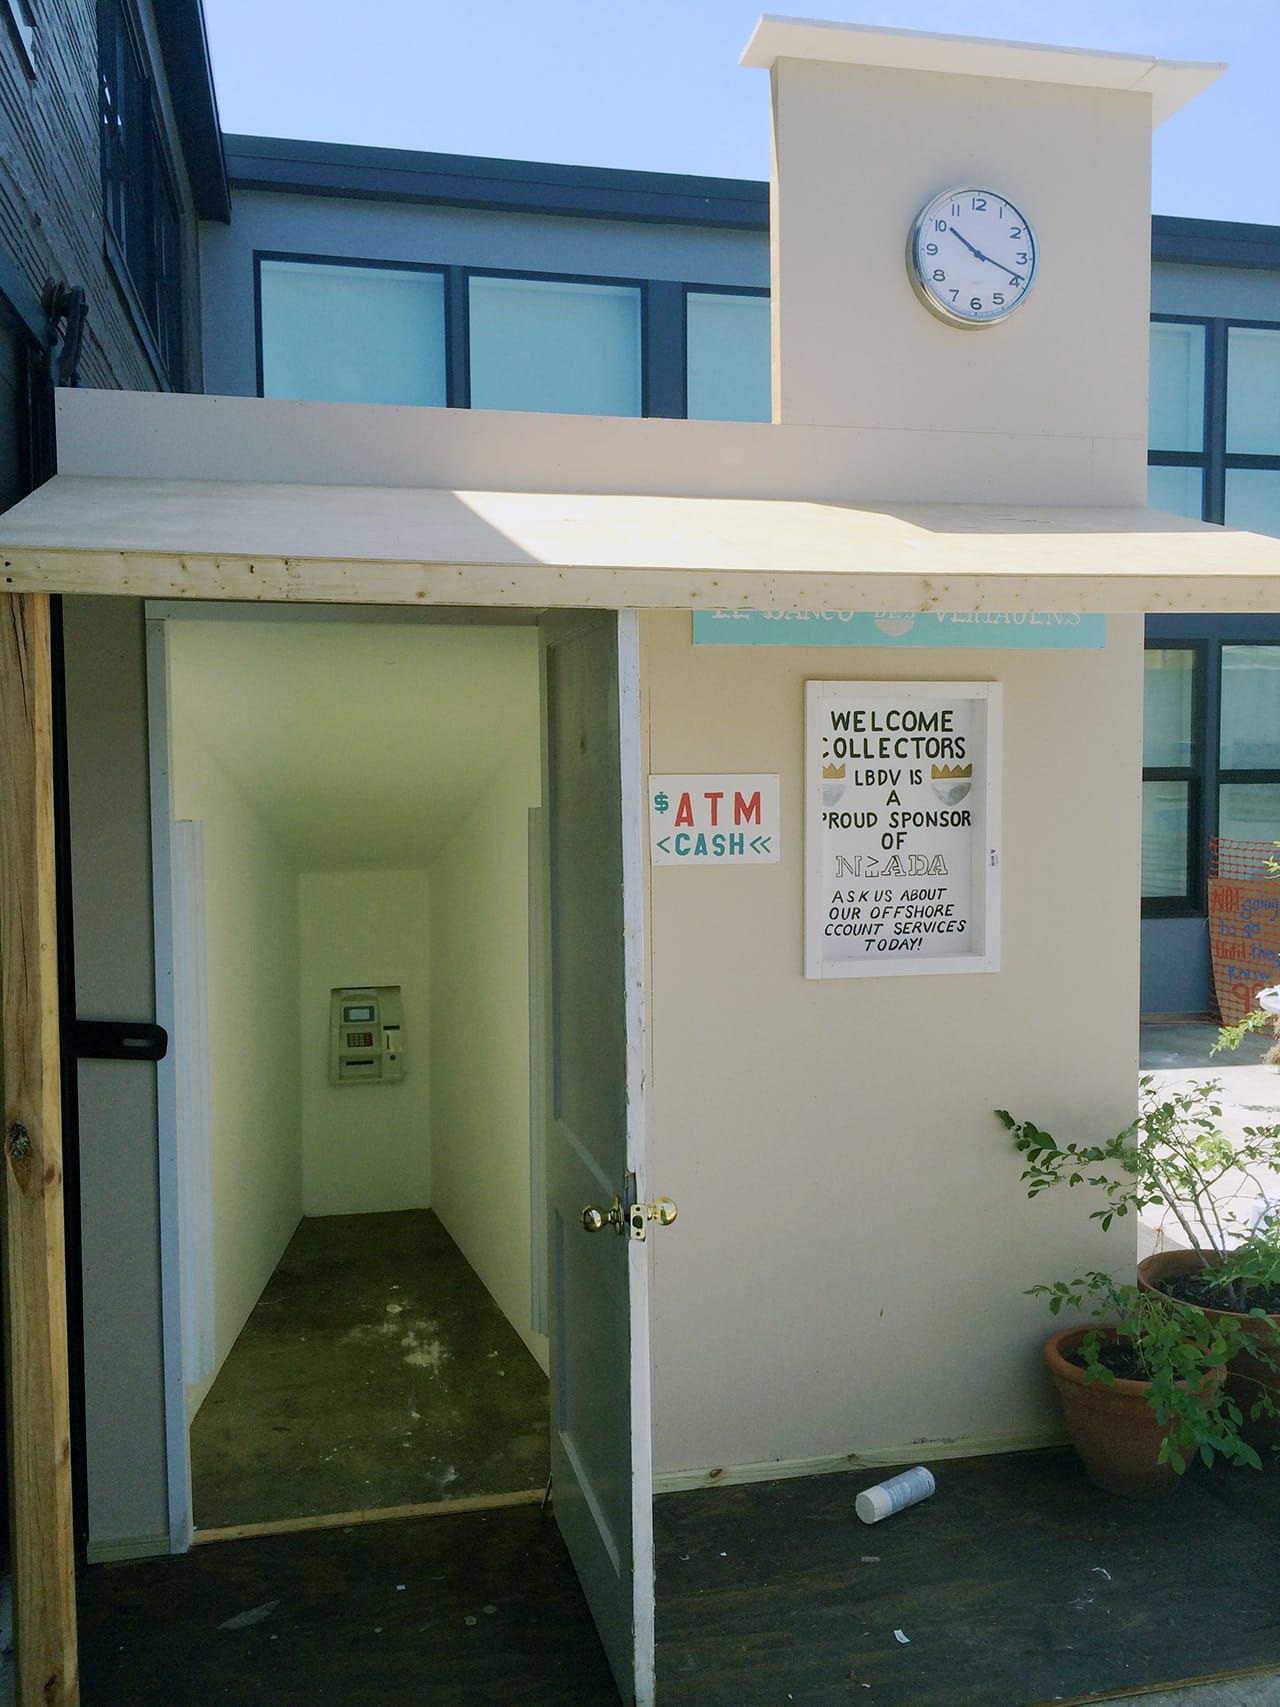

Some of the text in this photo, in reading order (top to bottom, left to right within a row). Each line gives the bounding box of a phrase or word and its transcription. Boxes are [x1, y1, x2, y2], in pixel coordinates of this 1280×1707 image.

[951, 204, 960, 217] 11
[972, 197, 987, 211] 12
[999, 206, 1003, 219] 1
[935, 219, 947, 232] 10
[1009, 227, 1022, 239] 2
[926, 243, 938, 255] 9
[1015, 252, 1028, 265] 3
[932, 269, 945, 282] 8
[1008, 275, 1020, 289] 4
[949, 289, 960, 302] 7
[992, 292, 1005, 305] 5
[970, 297, 982, 311] 6
[830, 710, 954, 733] WELCOME
[854, 769, 923, 786] LBDV IS
[886, 790, 901, 807] A
[888, 810, 972, 829] SPONSOR
[881, 831, 908, 850] OF
[831, 887, 947, 904] ASK US ABOUT
[828, 904, 955, 920] OUR OFFSHORE
[824, 919, 967, 936] CCOUNT SERVICES
[864, 937, 923, 952] TODAY!
